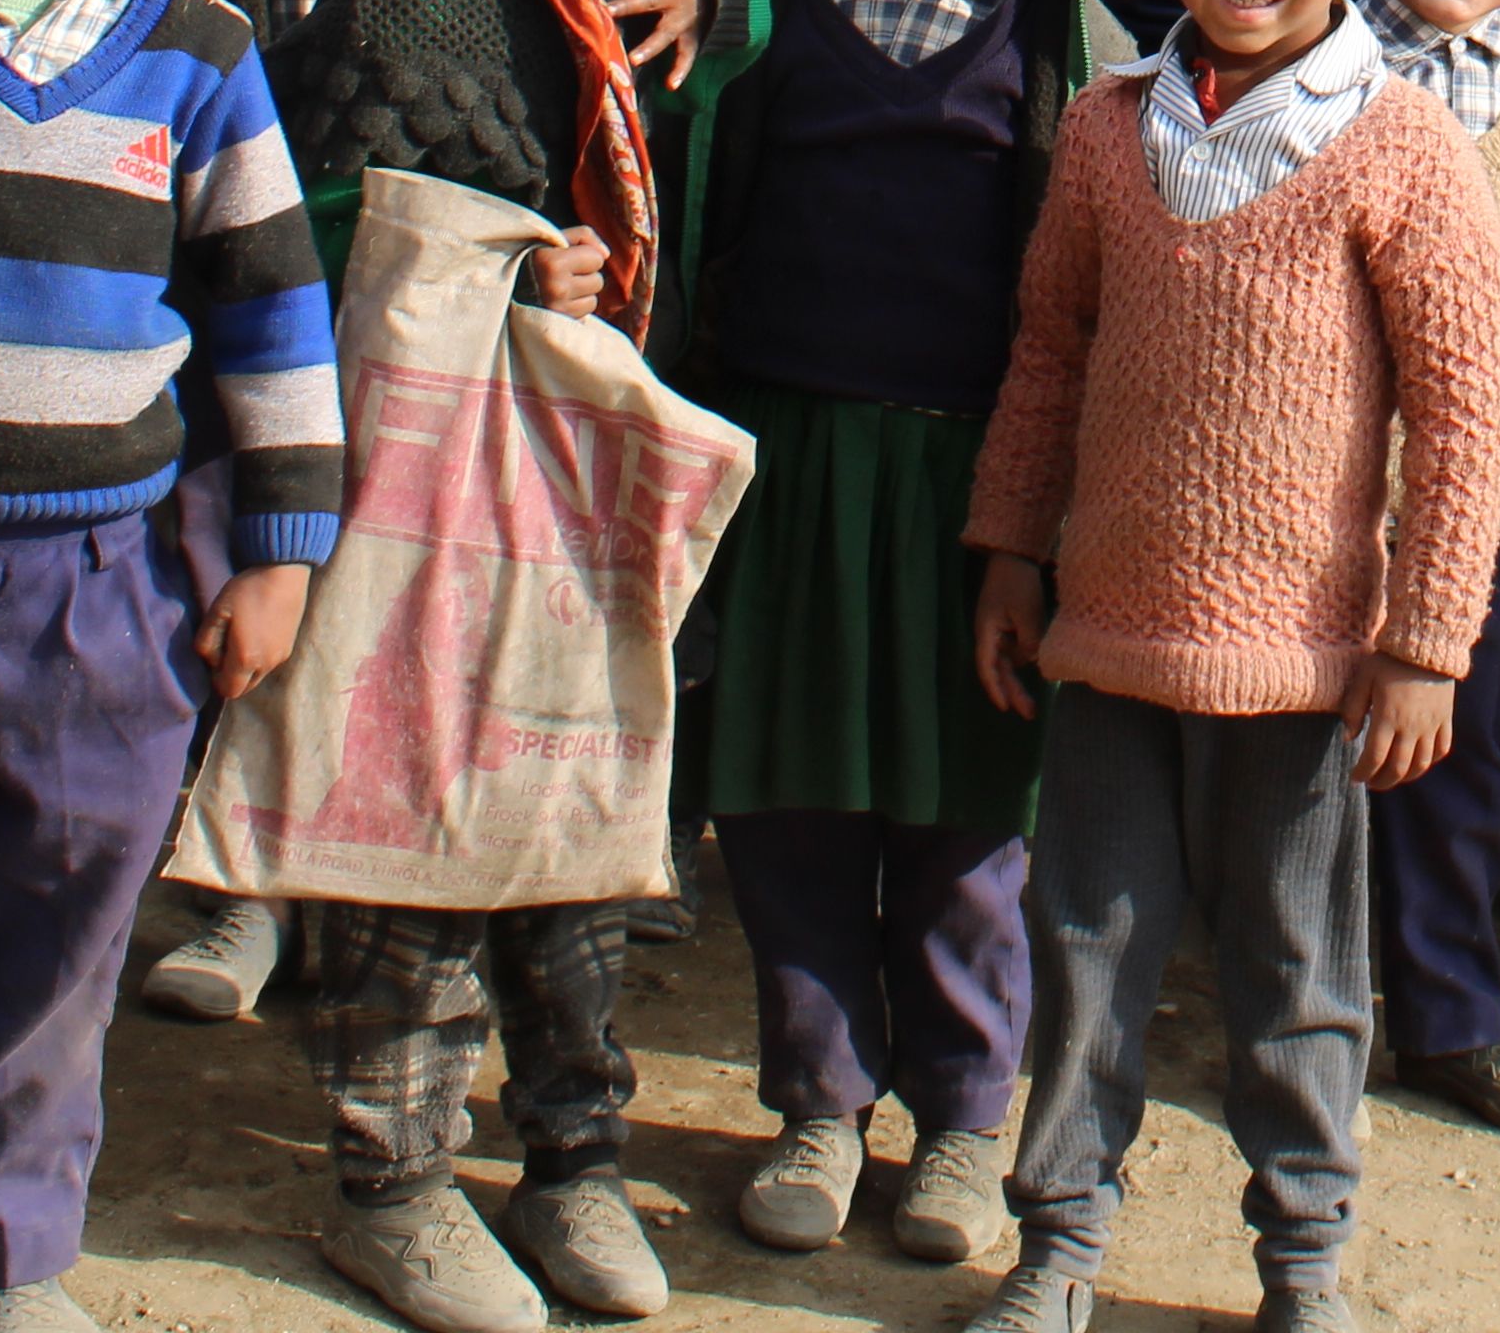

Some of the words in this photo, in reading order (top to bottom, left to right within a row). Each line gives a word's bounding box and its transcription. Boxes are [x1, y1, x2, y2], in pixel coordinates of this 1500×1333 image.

[115, 156, 168, 190] adidas
[354, 377, 710, 545] FINE
[505, 728, 659, 765] SPECIALIST
